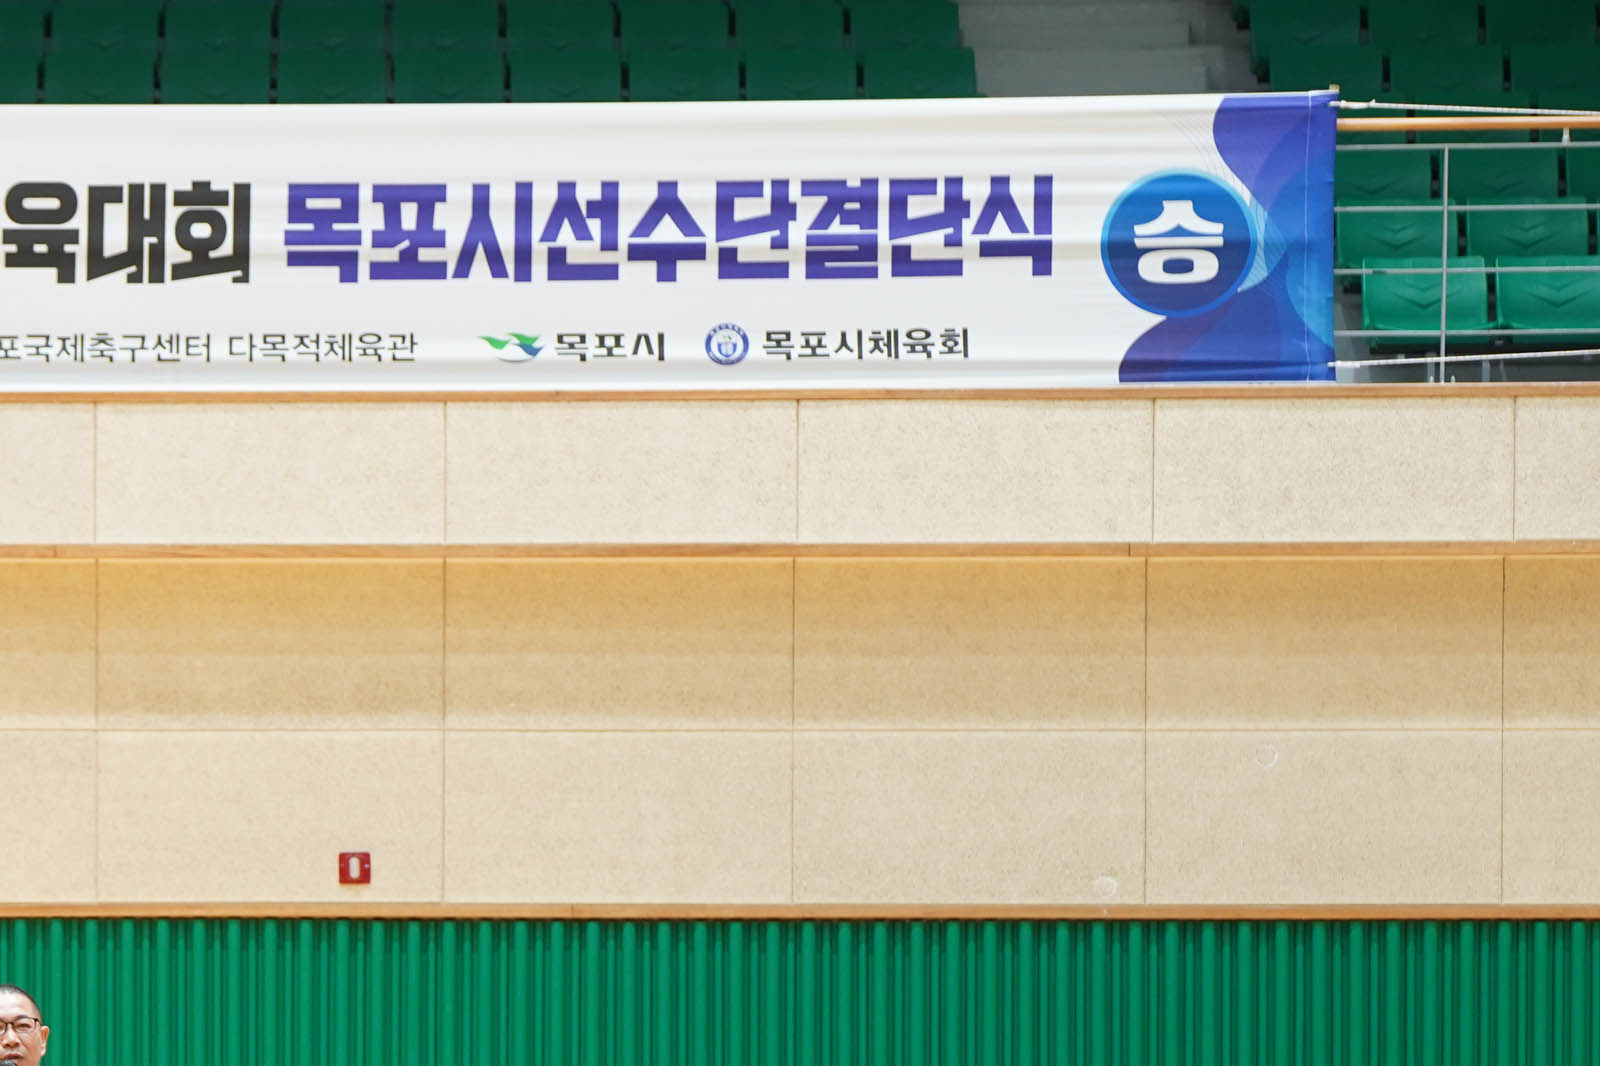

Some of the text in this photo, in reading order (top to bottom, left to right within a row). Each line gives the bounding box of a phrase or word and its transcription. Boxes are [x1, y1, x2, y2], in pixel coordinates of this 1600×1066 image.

[284, 174, 1053, 283] 목포시선수단결단식
[1133, 199, 1224, 285] 승
[228, 333, 419, 363] 다목적체육관
[554, 332, 666, 363] 목포시
[761, 327, 970, 361] 목포시체육회
